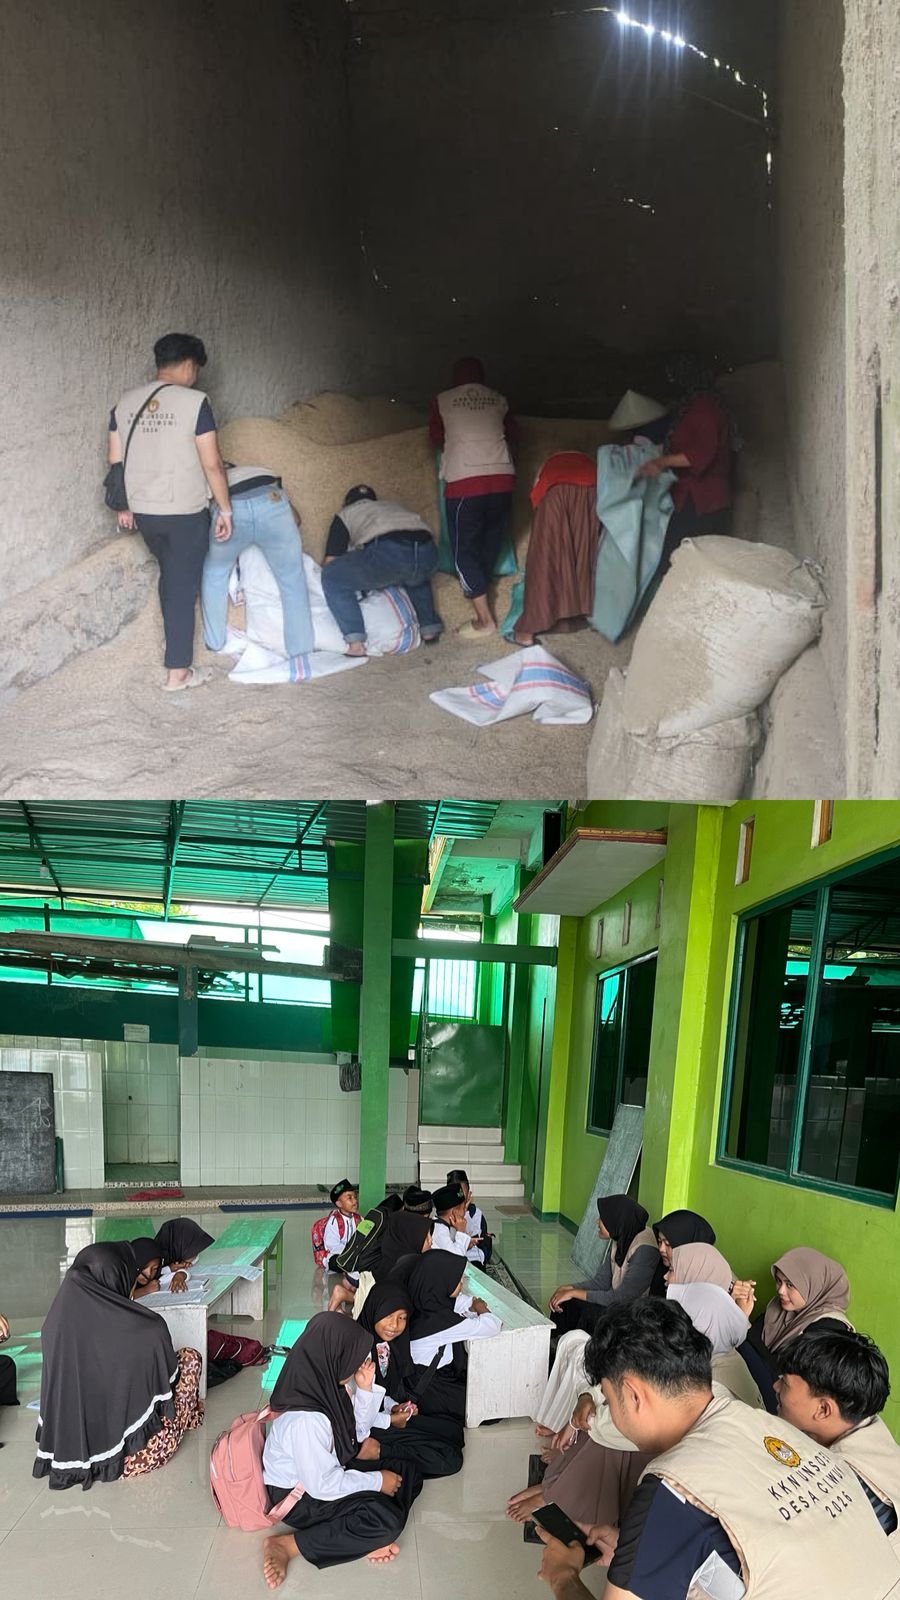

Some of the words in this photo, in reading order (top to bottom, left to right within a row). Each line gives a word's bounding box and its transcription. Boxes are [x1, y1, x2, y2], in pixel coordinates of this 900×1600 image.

[768, 1474, 801, 1501] KKN
[778, 1490, 820, 1521] DESA
[825, 1490, 853, 1519] 2026
